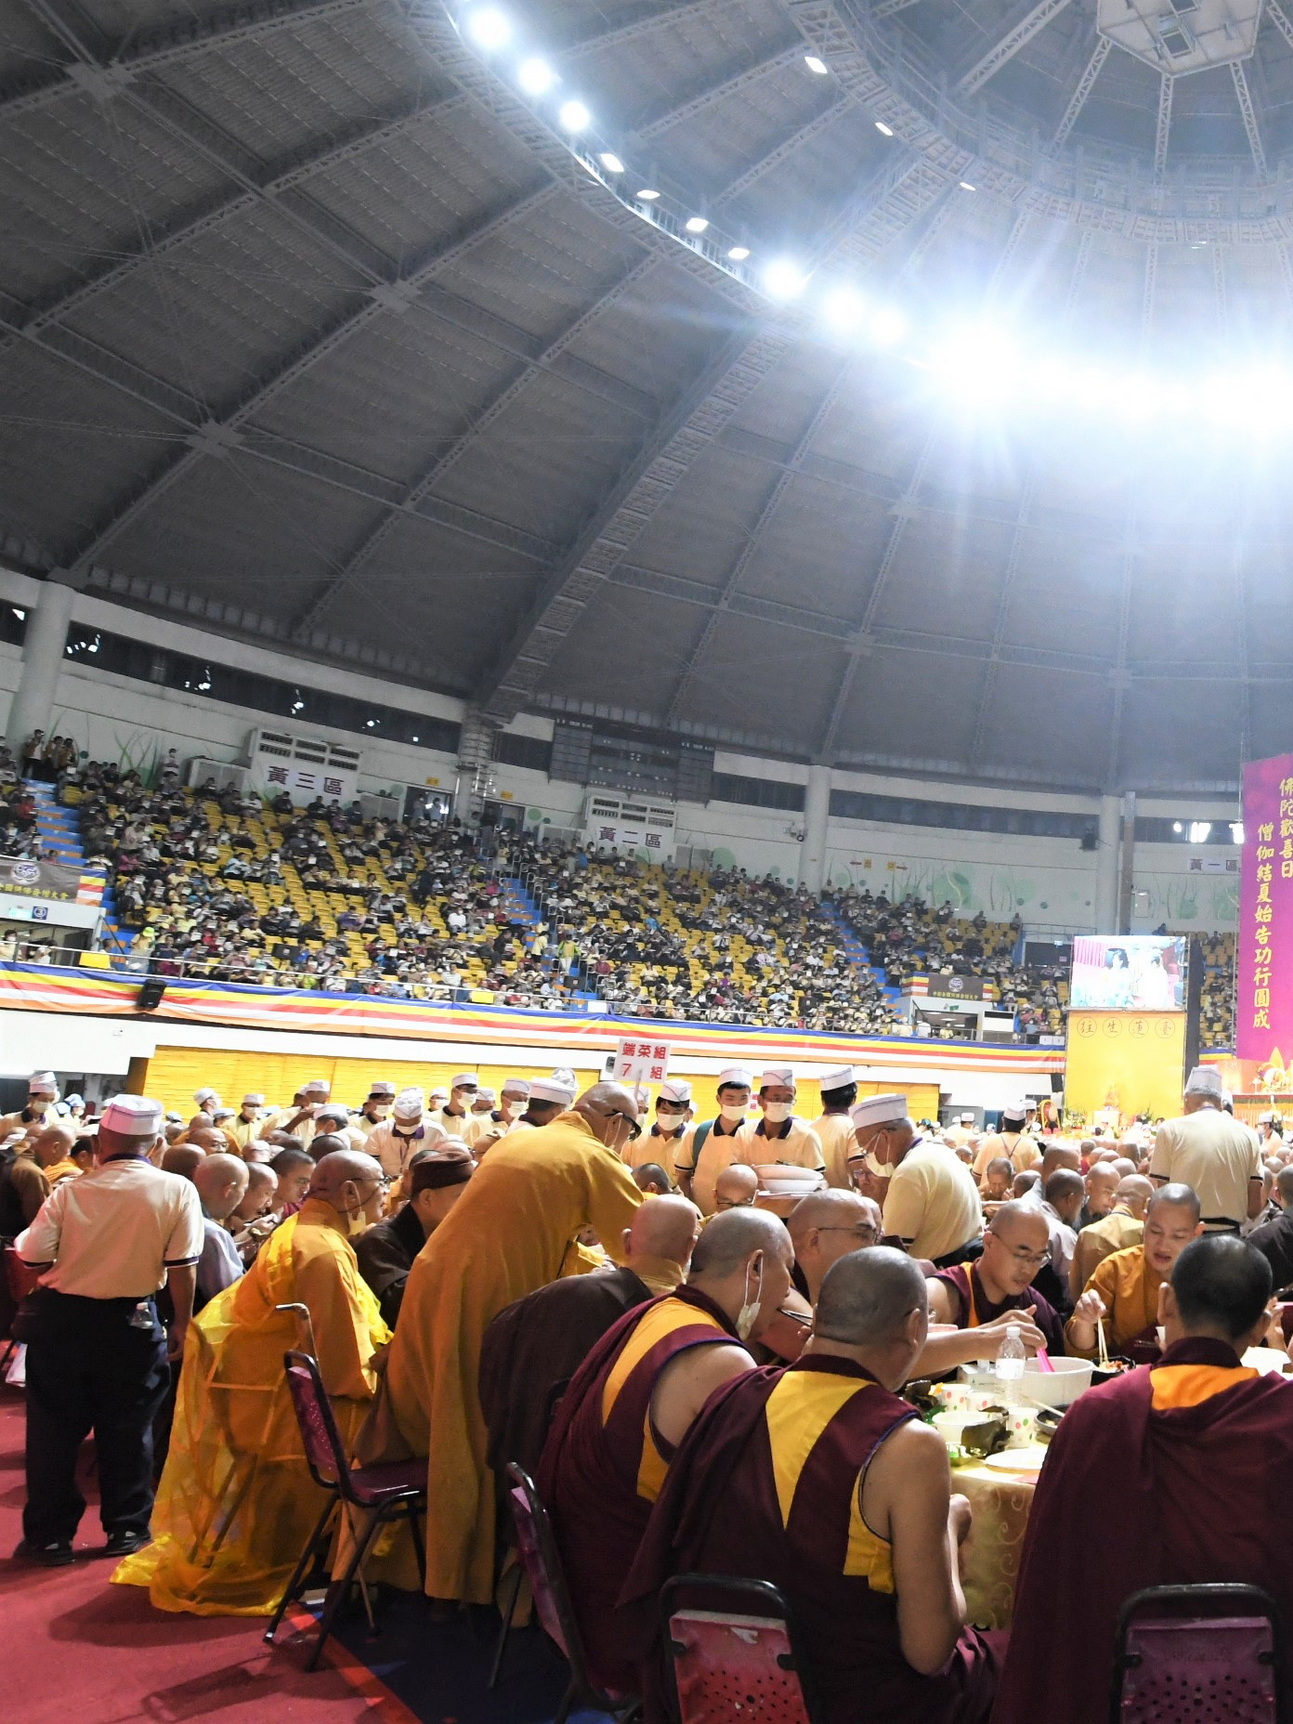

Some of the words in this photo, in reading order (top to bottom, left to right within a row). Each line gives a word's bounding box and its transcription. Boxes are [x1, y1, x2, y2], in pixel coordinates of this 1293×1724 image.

[1252, 822, 1275, 1030] 僧伽結夏始告功行圓成
[622, 1063, 632, 1077] 7
[650, 1065, 663, 1080] 組
